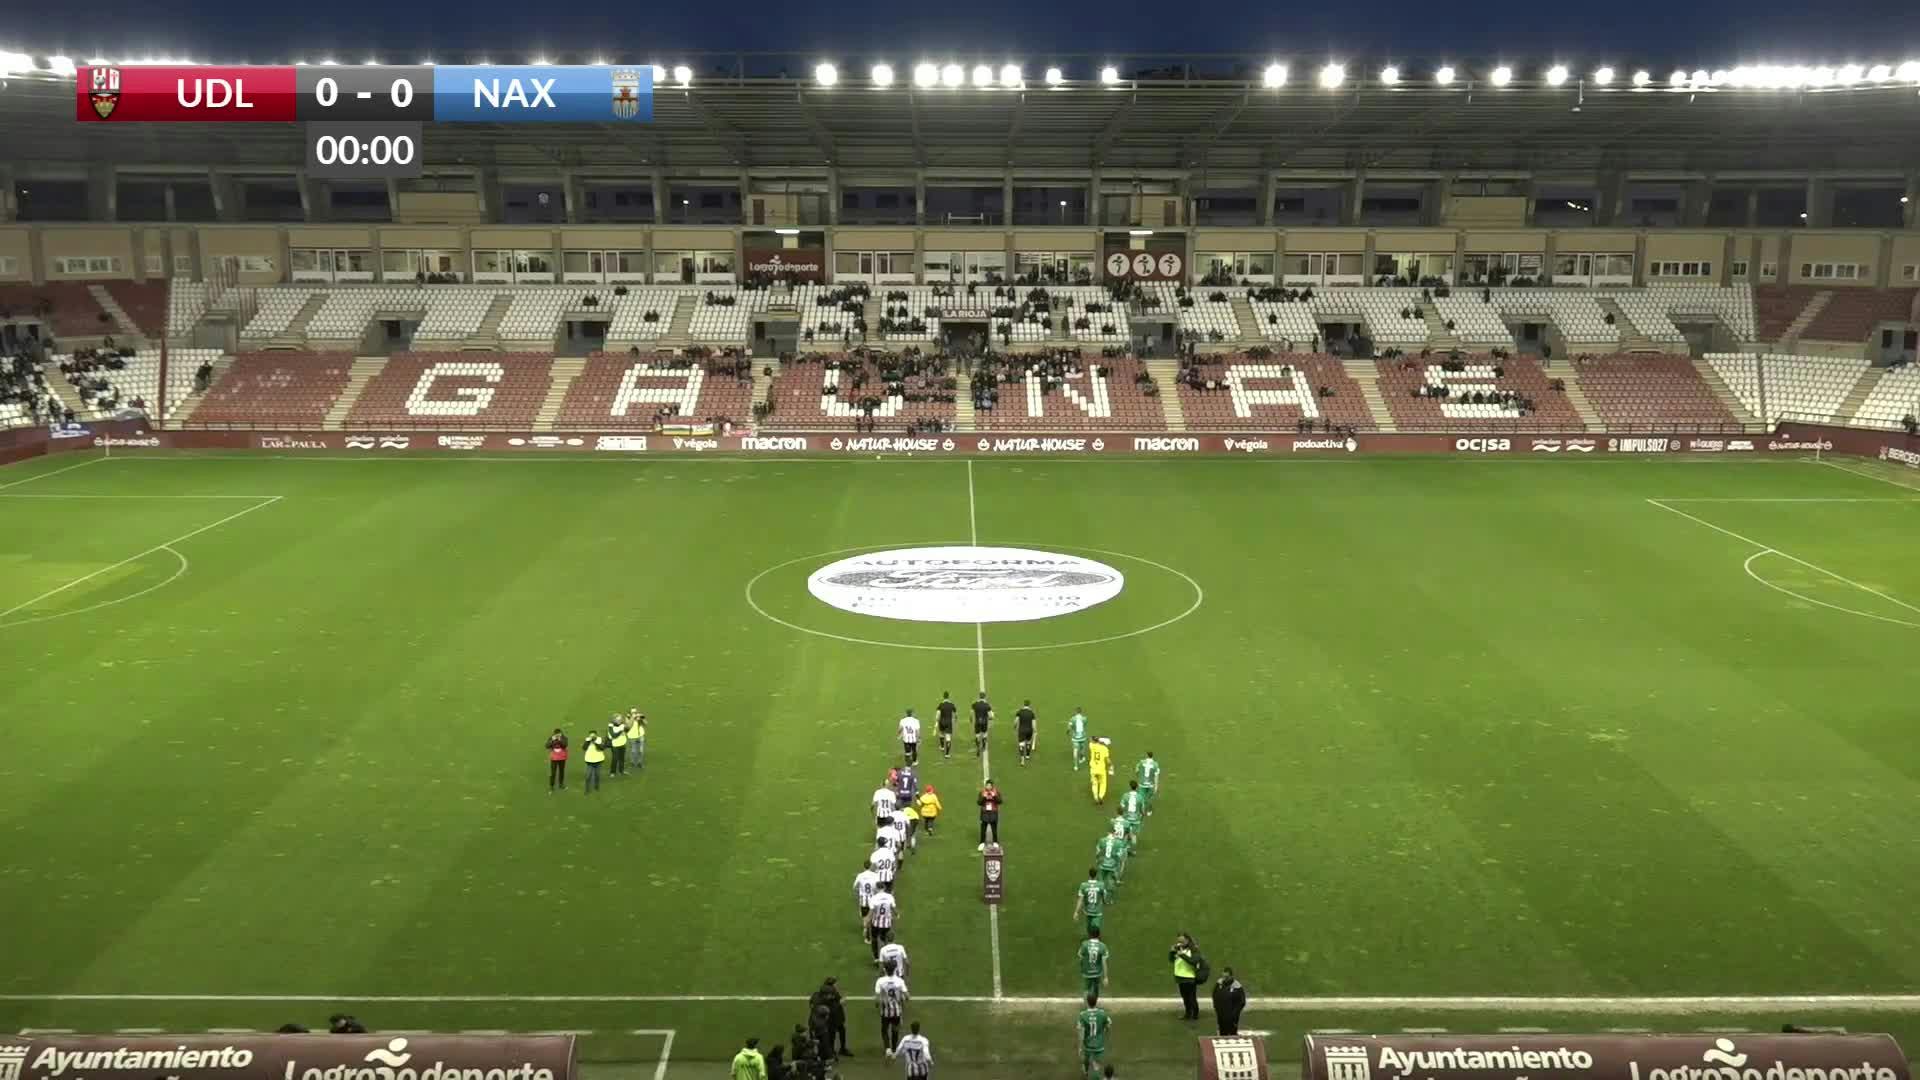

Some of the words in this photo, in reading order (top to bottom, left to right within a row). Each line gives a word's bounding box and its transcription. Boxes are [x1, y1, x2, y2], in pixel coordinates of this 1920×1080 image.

[943, 310, 957, 318] LA
[959, 310, 987, 318] RIOJA
[741, 437, 806, 450] macron
[1134, 438, 1198, 450] macron
[1293, 440, 1343, 452] podoactiva
[1619, 438, 1668, 452] IMPULSO27
[902, 778, 908, 788] 1
[878, 859, 891, 870] 20
[864, 883, 872, 894] 8
[879, 904, 886, 915] 6
[887, 989, 895, 1000] 9
[31, 1045, 253, 1076] Ayuntamiento
[1378, 1046, 1593, 1075] Ayuntamiento
